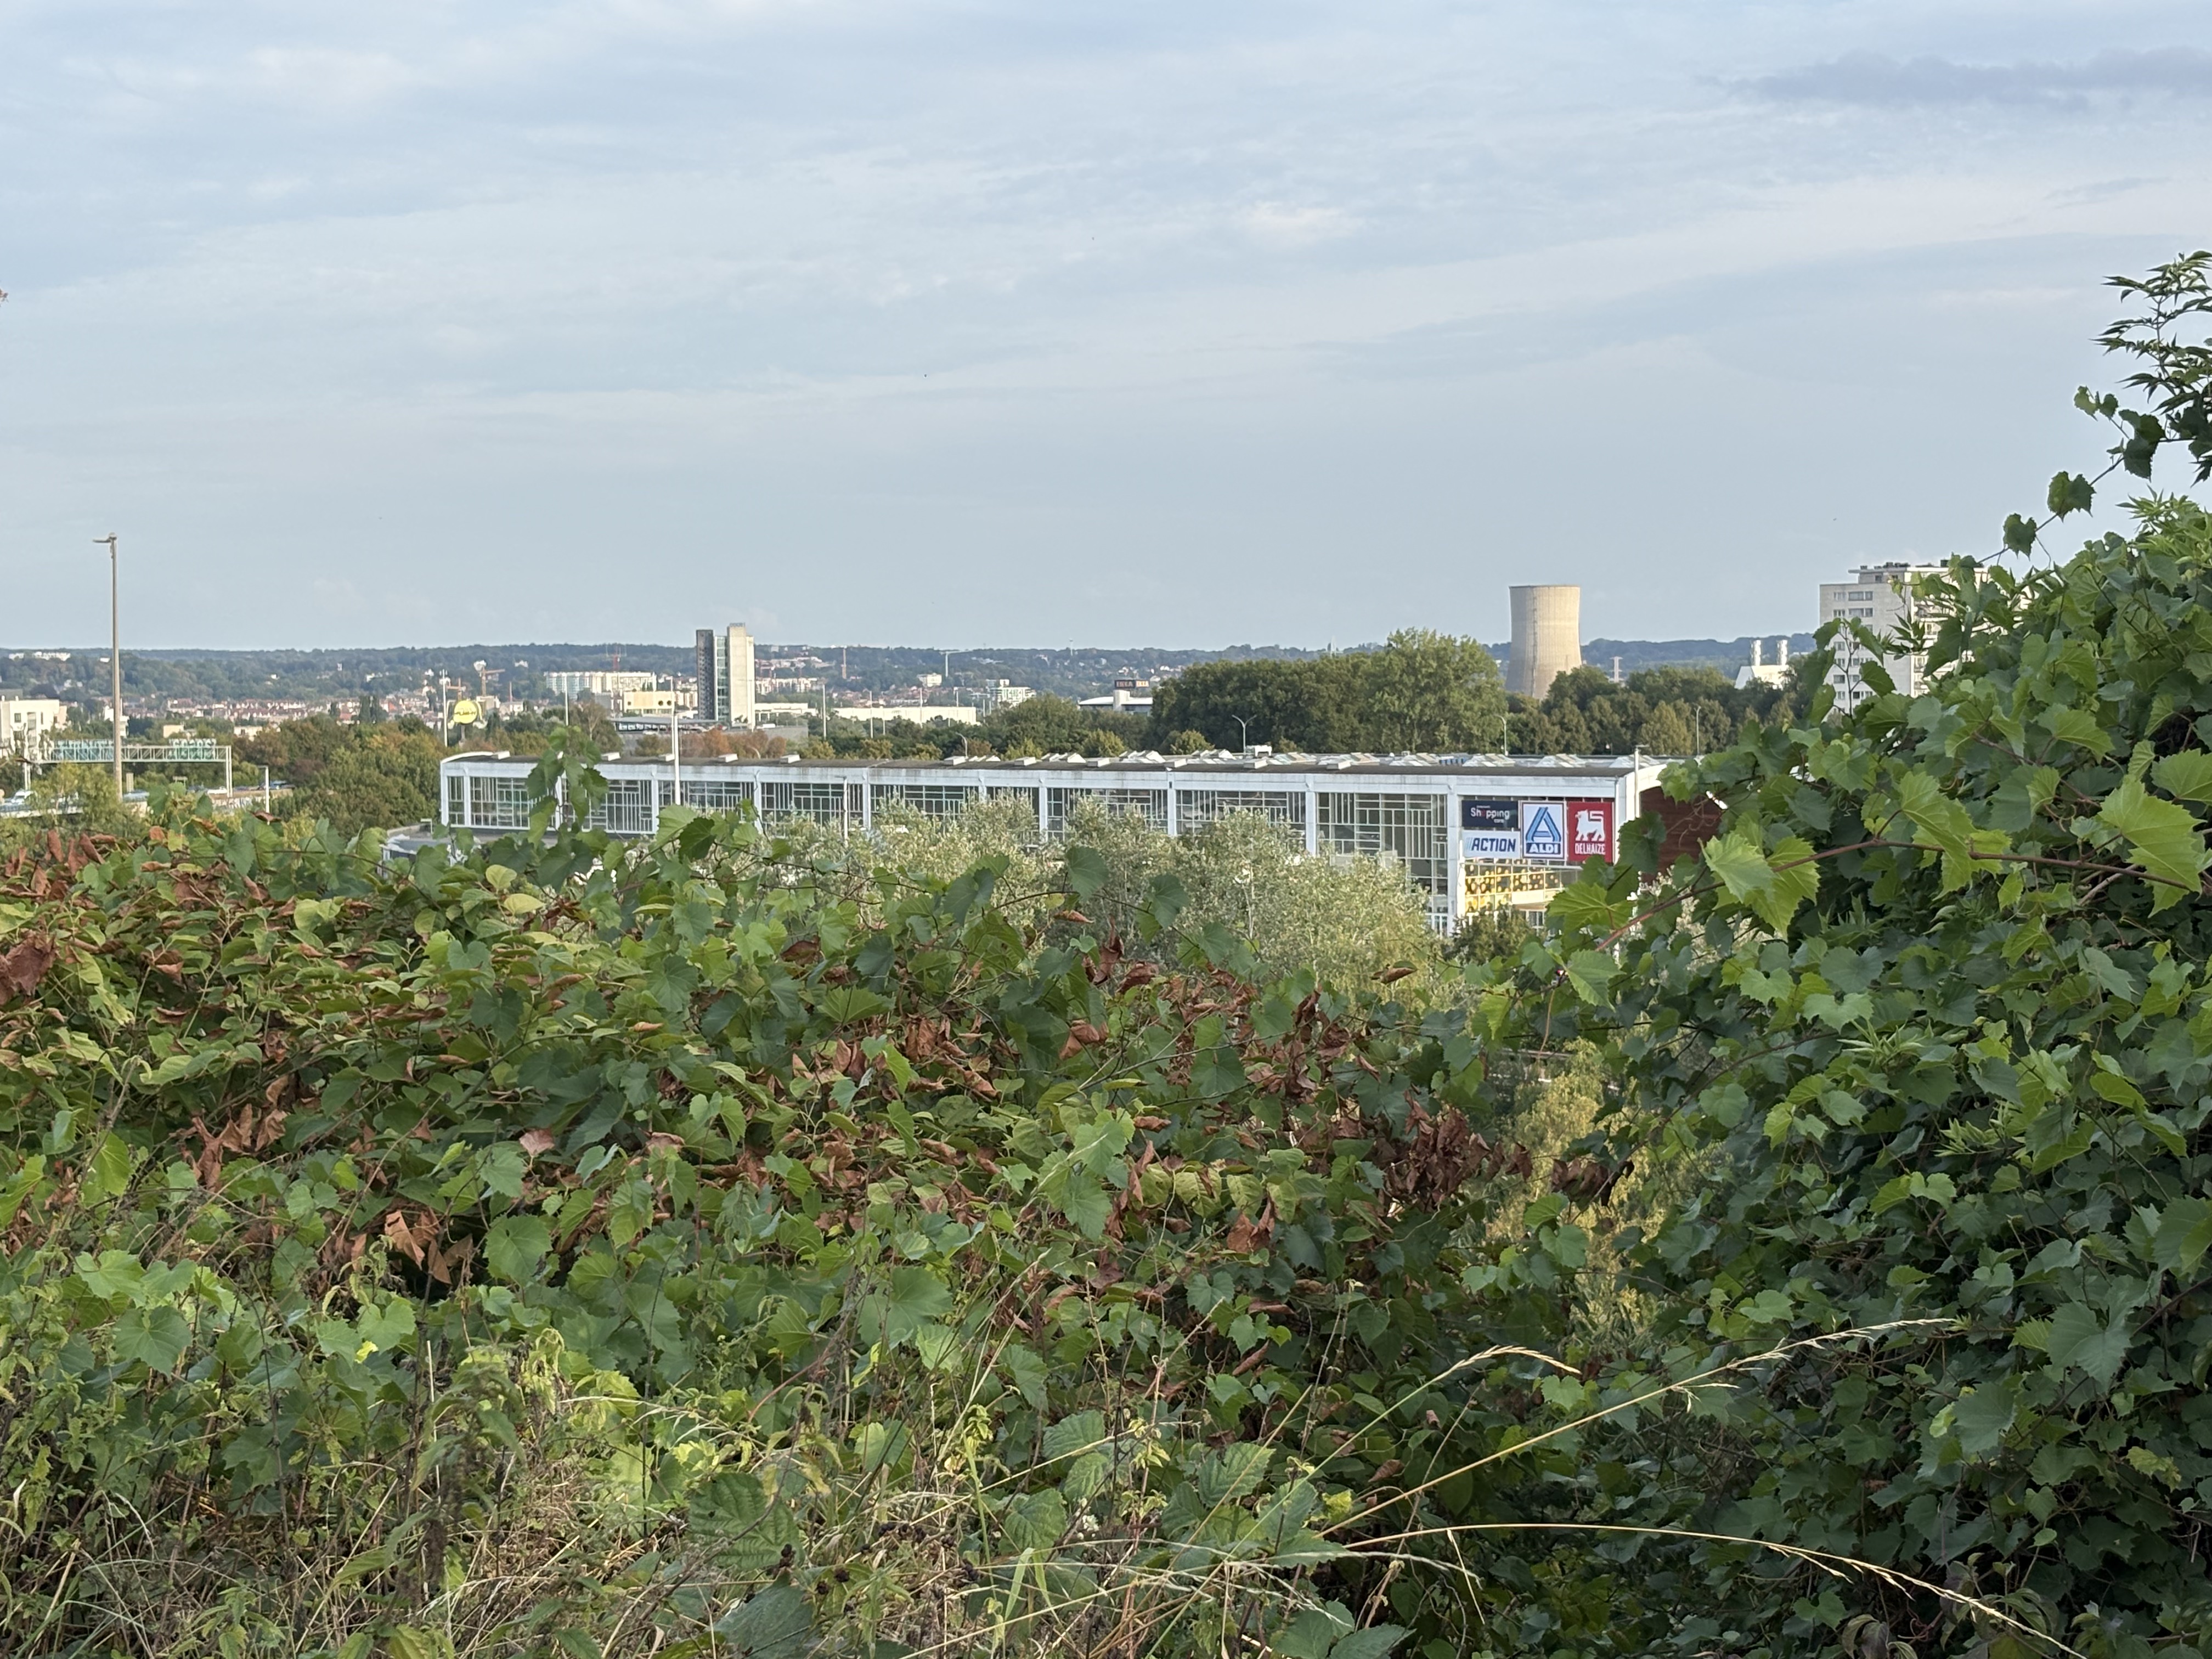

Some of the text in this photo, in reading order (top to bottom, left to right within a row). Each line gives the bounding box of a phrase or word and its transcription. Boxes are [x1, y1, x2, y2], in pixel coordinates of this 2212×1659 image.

[1471, 838, 1516, 852] ACTION
[1529, 843, 1559, 854] ALDI
[1575, 842, 1606, 855] DELHAIZE
